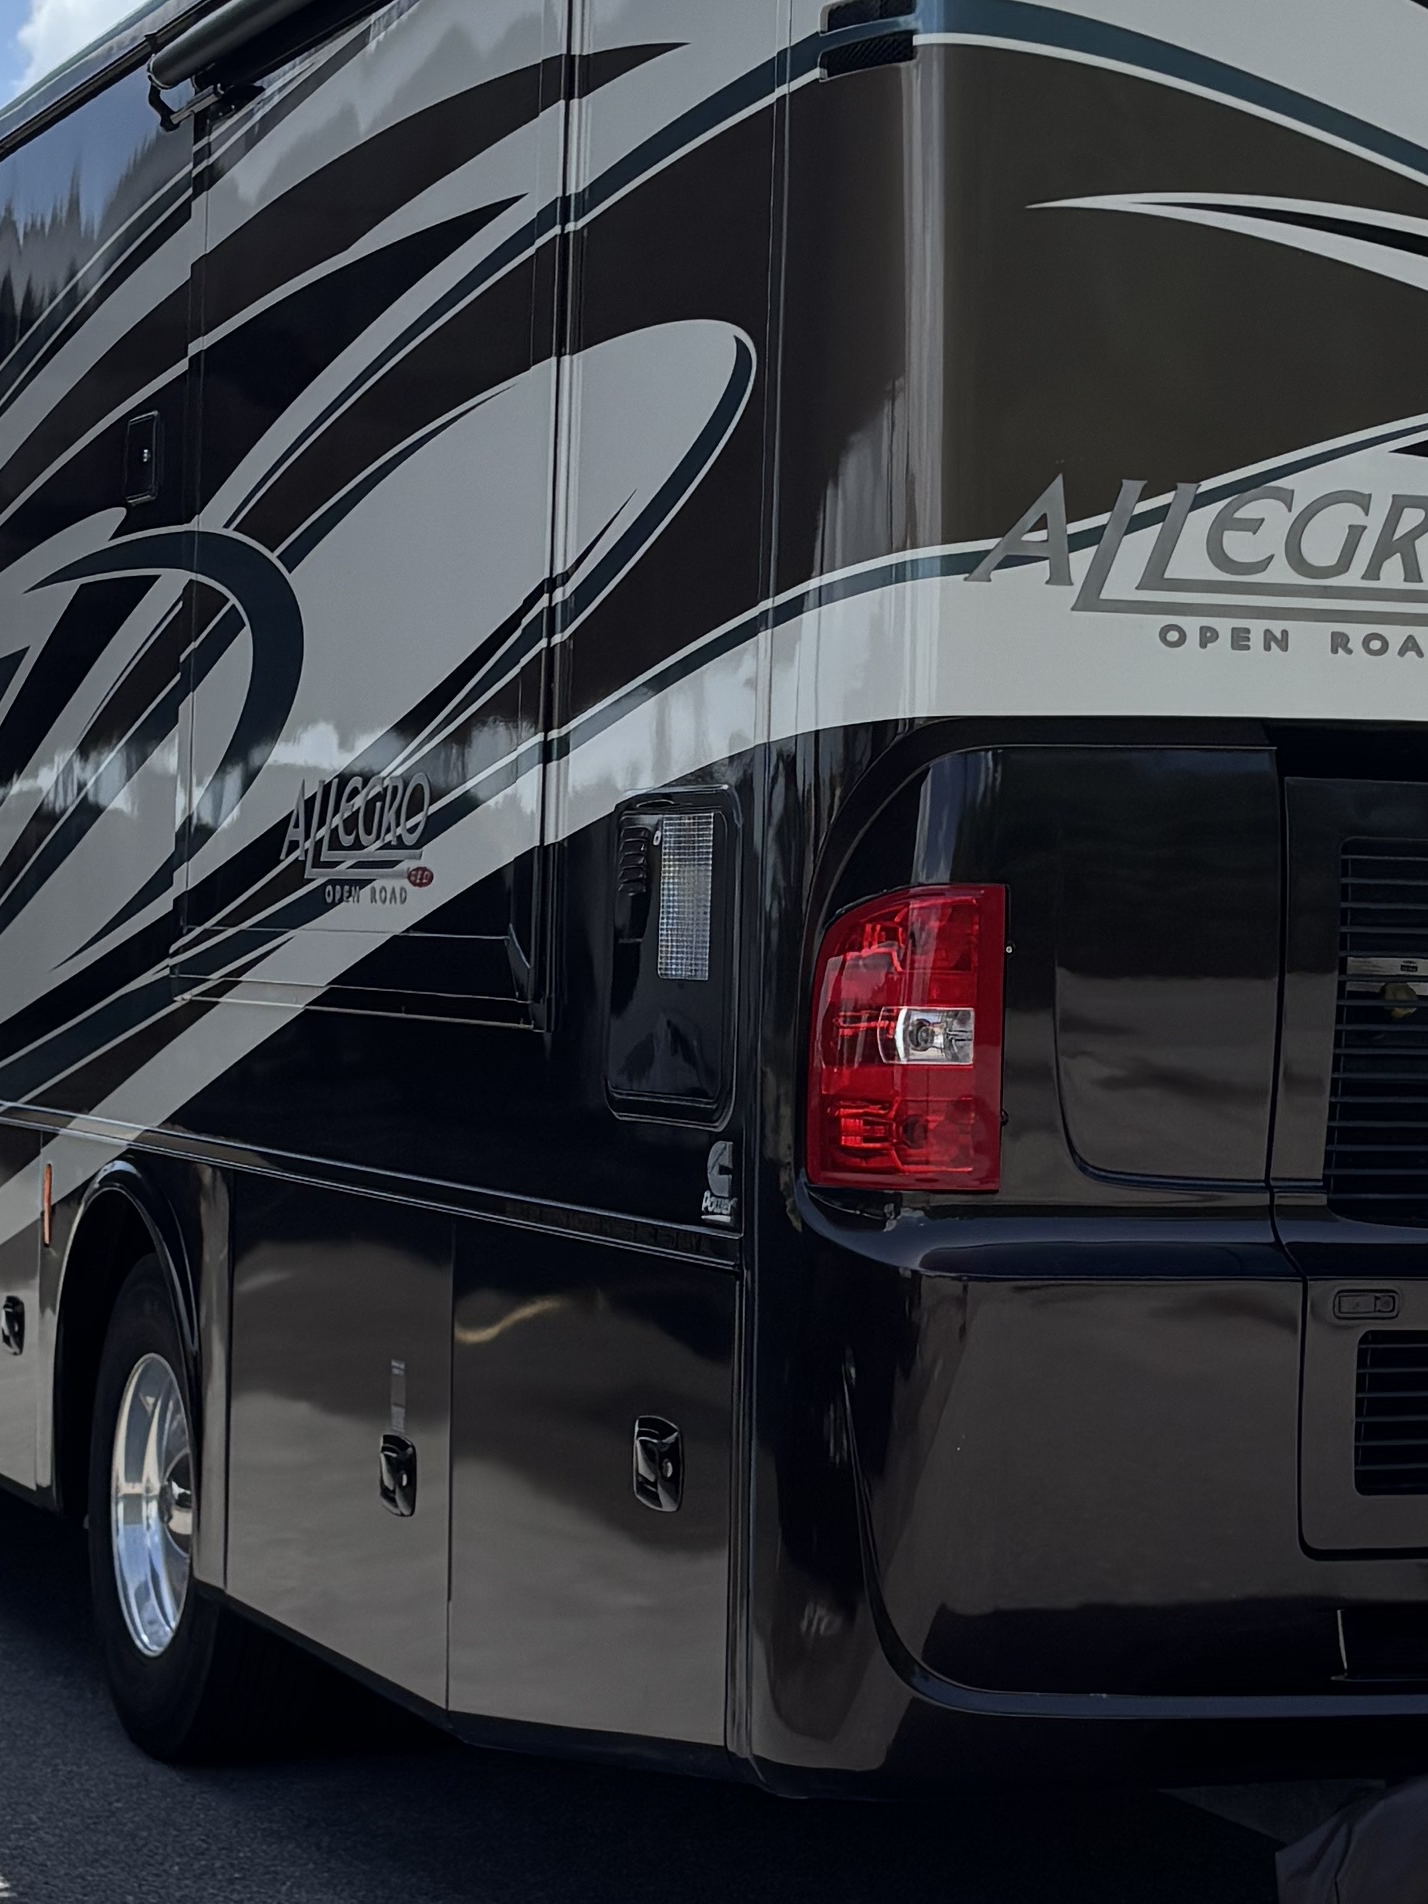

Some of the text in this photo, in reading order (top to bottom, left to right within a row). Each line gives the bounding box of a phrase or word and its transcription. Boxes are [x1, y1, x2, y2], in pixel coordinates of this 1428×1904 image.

[1158, 623, 1290, 653] OPEN
[279, 772, 431, 879] ALLEGRO
[325, 884, 408, 905] OPEN ROAD
